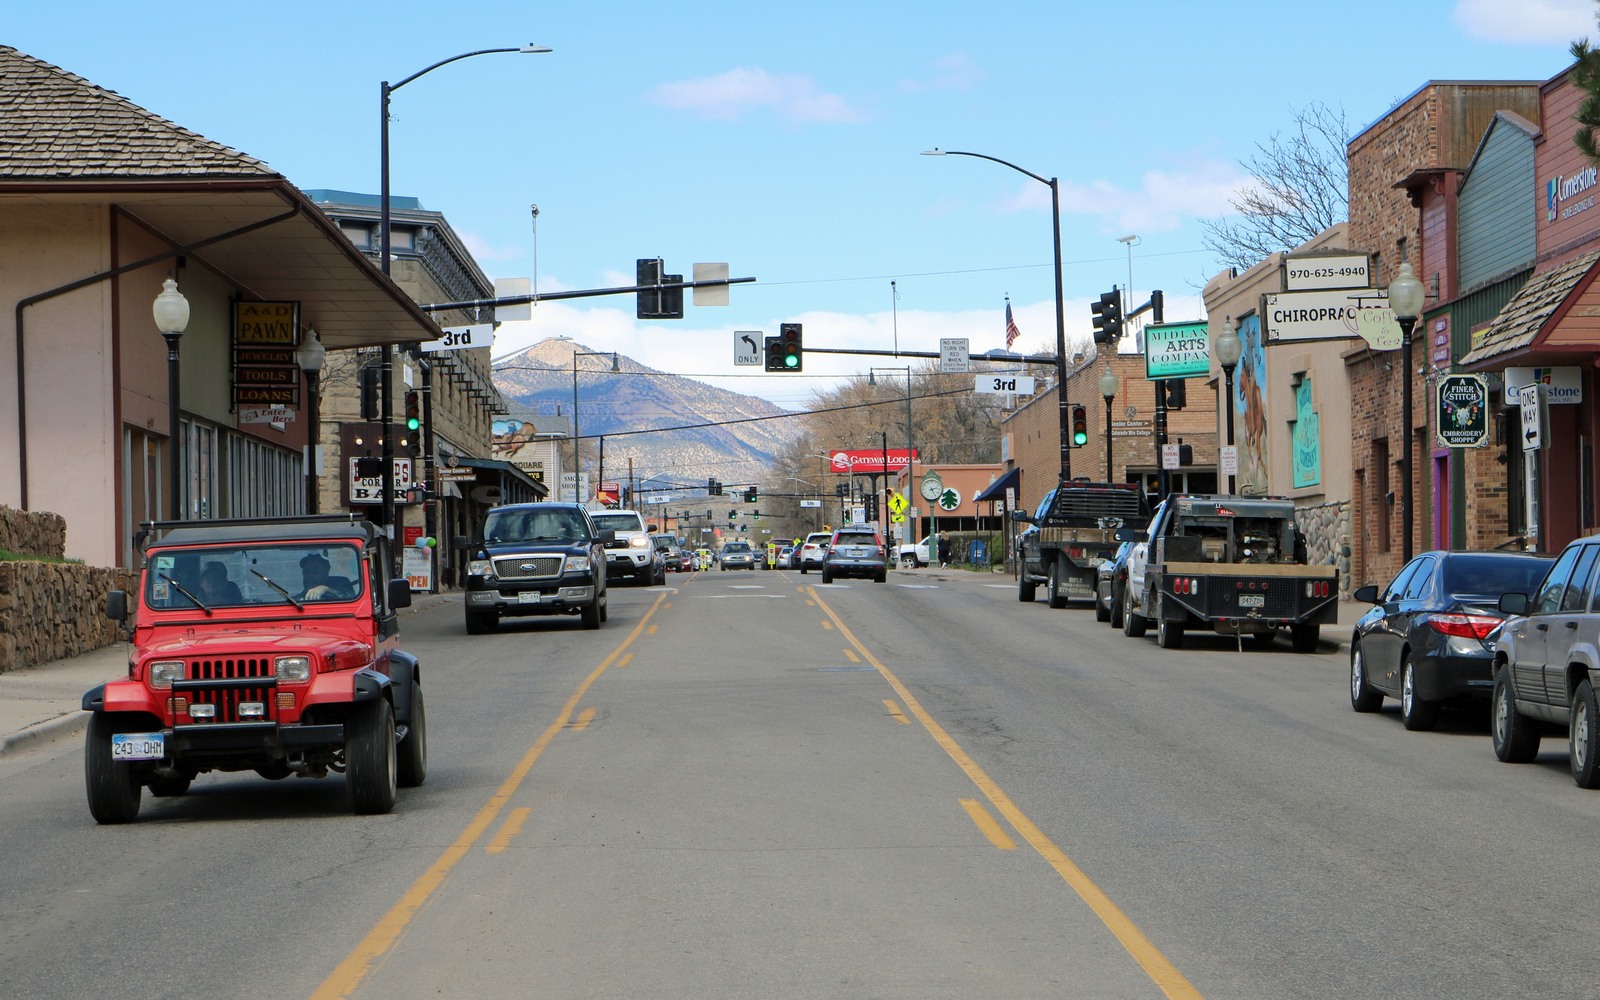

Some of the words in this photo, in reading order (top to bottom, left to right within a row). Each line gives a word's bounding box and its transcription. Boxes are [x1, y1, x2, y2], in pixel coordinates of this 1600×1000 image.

[1558, 165, 1598, 203] Cornerstone
[1290, 267, 1365, 279] 970-625-4940
[243, 306, 260, 316] A
[262, 306, 272, 316] &
[275, 306, 289, 316] D
[241, 319, 289, 339] PAWN
[443, 329, 472, 346] 3rd
[1166, 338, 1206, 353] ARTS
[239, 351, 289, 361] JEWELRY
[738, 355, 759, 363] ONLY
[244, 371, 287, 381] TOOLS
[1459, 378, 1466, 386] A
[993, 378, 1016, 391] 3rd
[1451, 385, 1475, 393] FINER
[240, 390, 292, 400] LOANS
[1449, 393, 1477, 401] STITCH
[1522, 390, 1536, 407] ONE
[1522, 407, 1537, 425] WAY
[114, 742, 133, 755] 243
